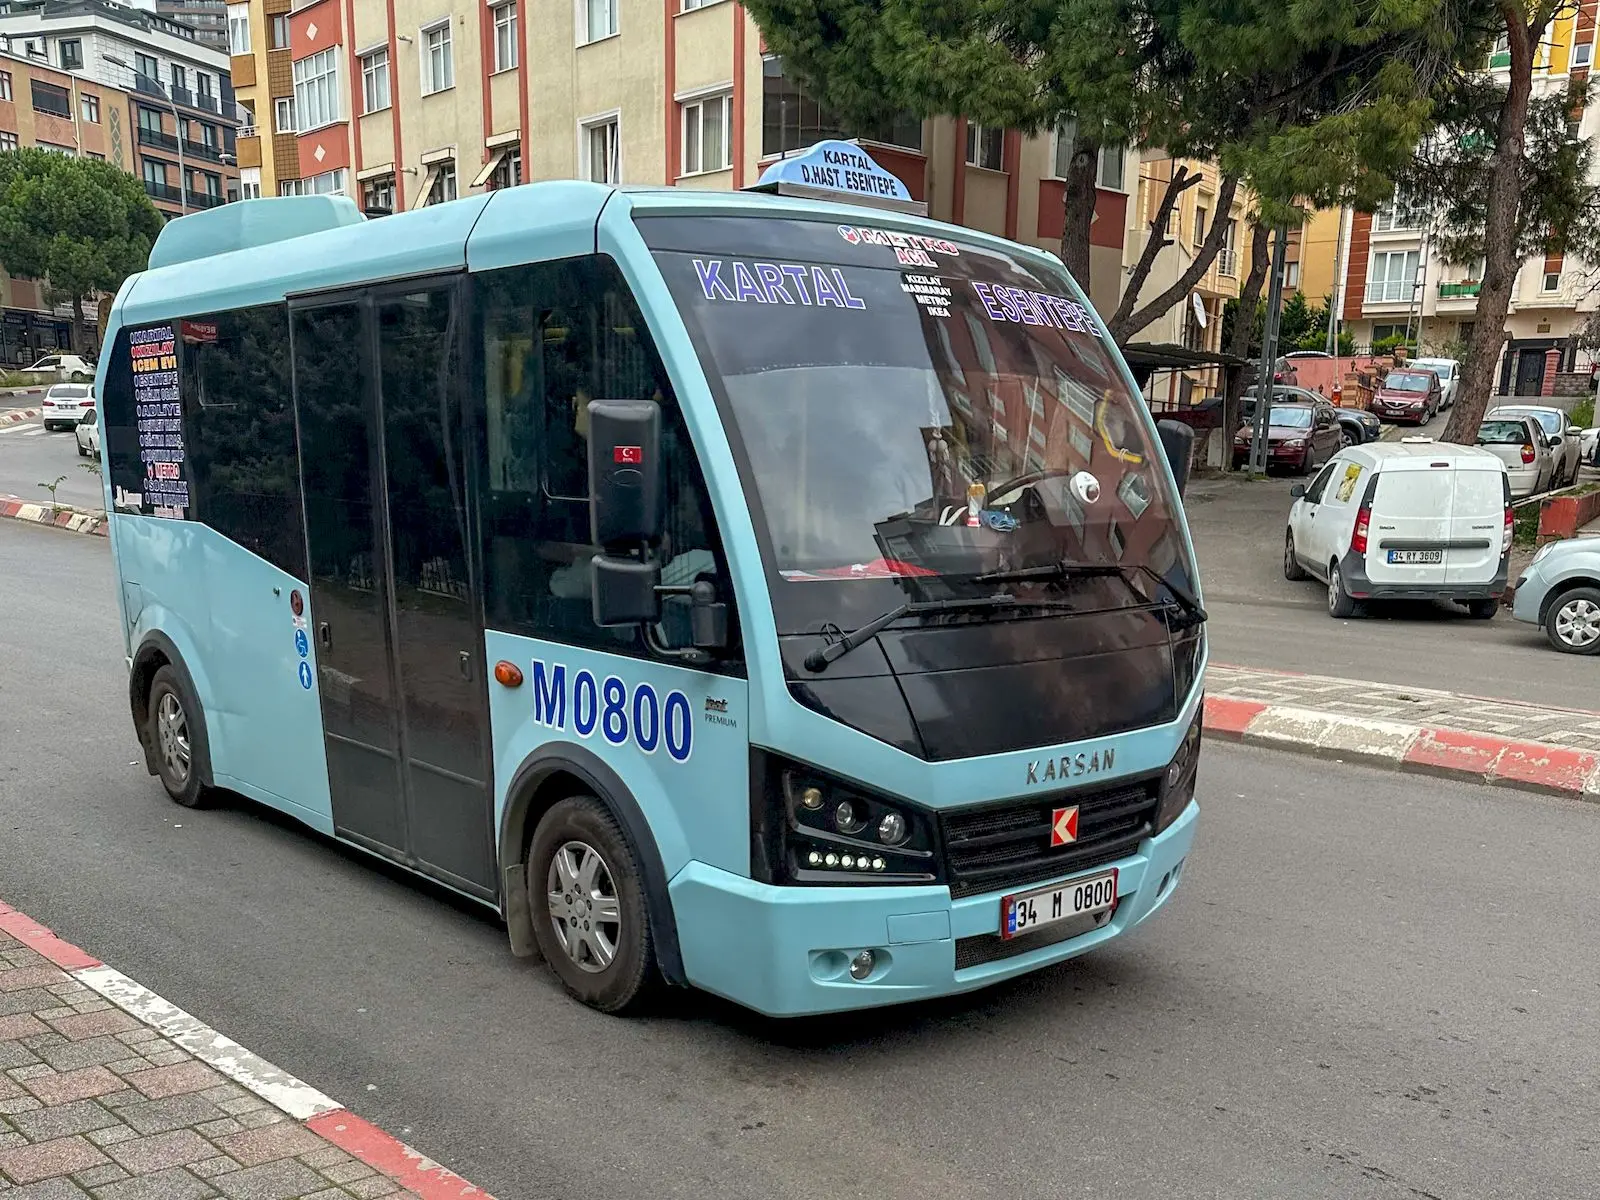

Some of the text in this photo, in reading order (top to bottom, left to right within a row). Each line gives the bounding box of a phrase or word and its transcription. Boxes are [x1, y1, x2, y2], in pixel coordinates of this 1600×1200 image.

[823, 150, 871, 171] KARTAL
[801, 164, 897, 196] D.HAST. ESENTEPE
[857, 227, 960, 257] METRO
[905, 274, 941, 286] KIZILAY
[692, 259, 1102, 337] KARTAL ESENTEPE
[900, 283, 952, 297] MARMARAY
[927, 306, 951, 317] IKEA
[134, 326, 175, 344] KARTAL
[135, 341, 175, 358] KIZILAY
[137, 358, 159, 372] CEM
[139, 371, 178, 387] ESENTEPE
[155, 462, 180, 479] METRO
[1393, 551, 1440, 561] 34 RY 3609
[531, 658, 693, 764] M0800
[704, 713, 737, 728] PREMIUM
[1026, 748, 1115, 785] KARSAN
[1017, 898, 1037, 928] 34
[1052, 891, 1062, 918] M
[1074, 879, 1113, 912] 0800
